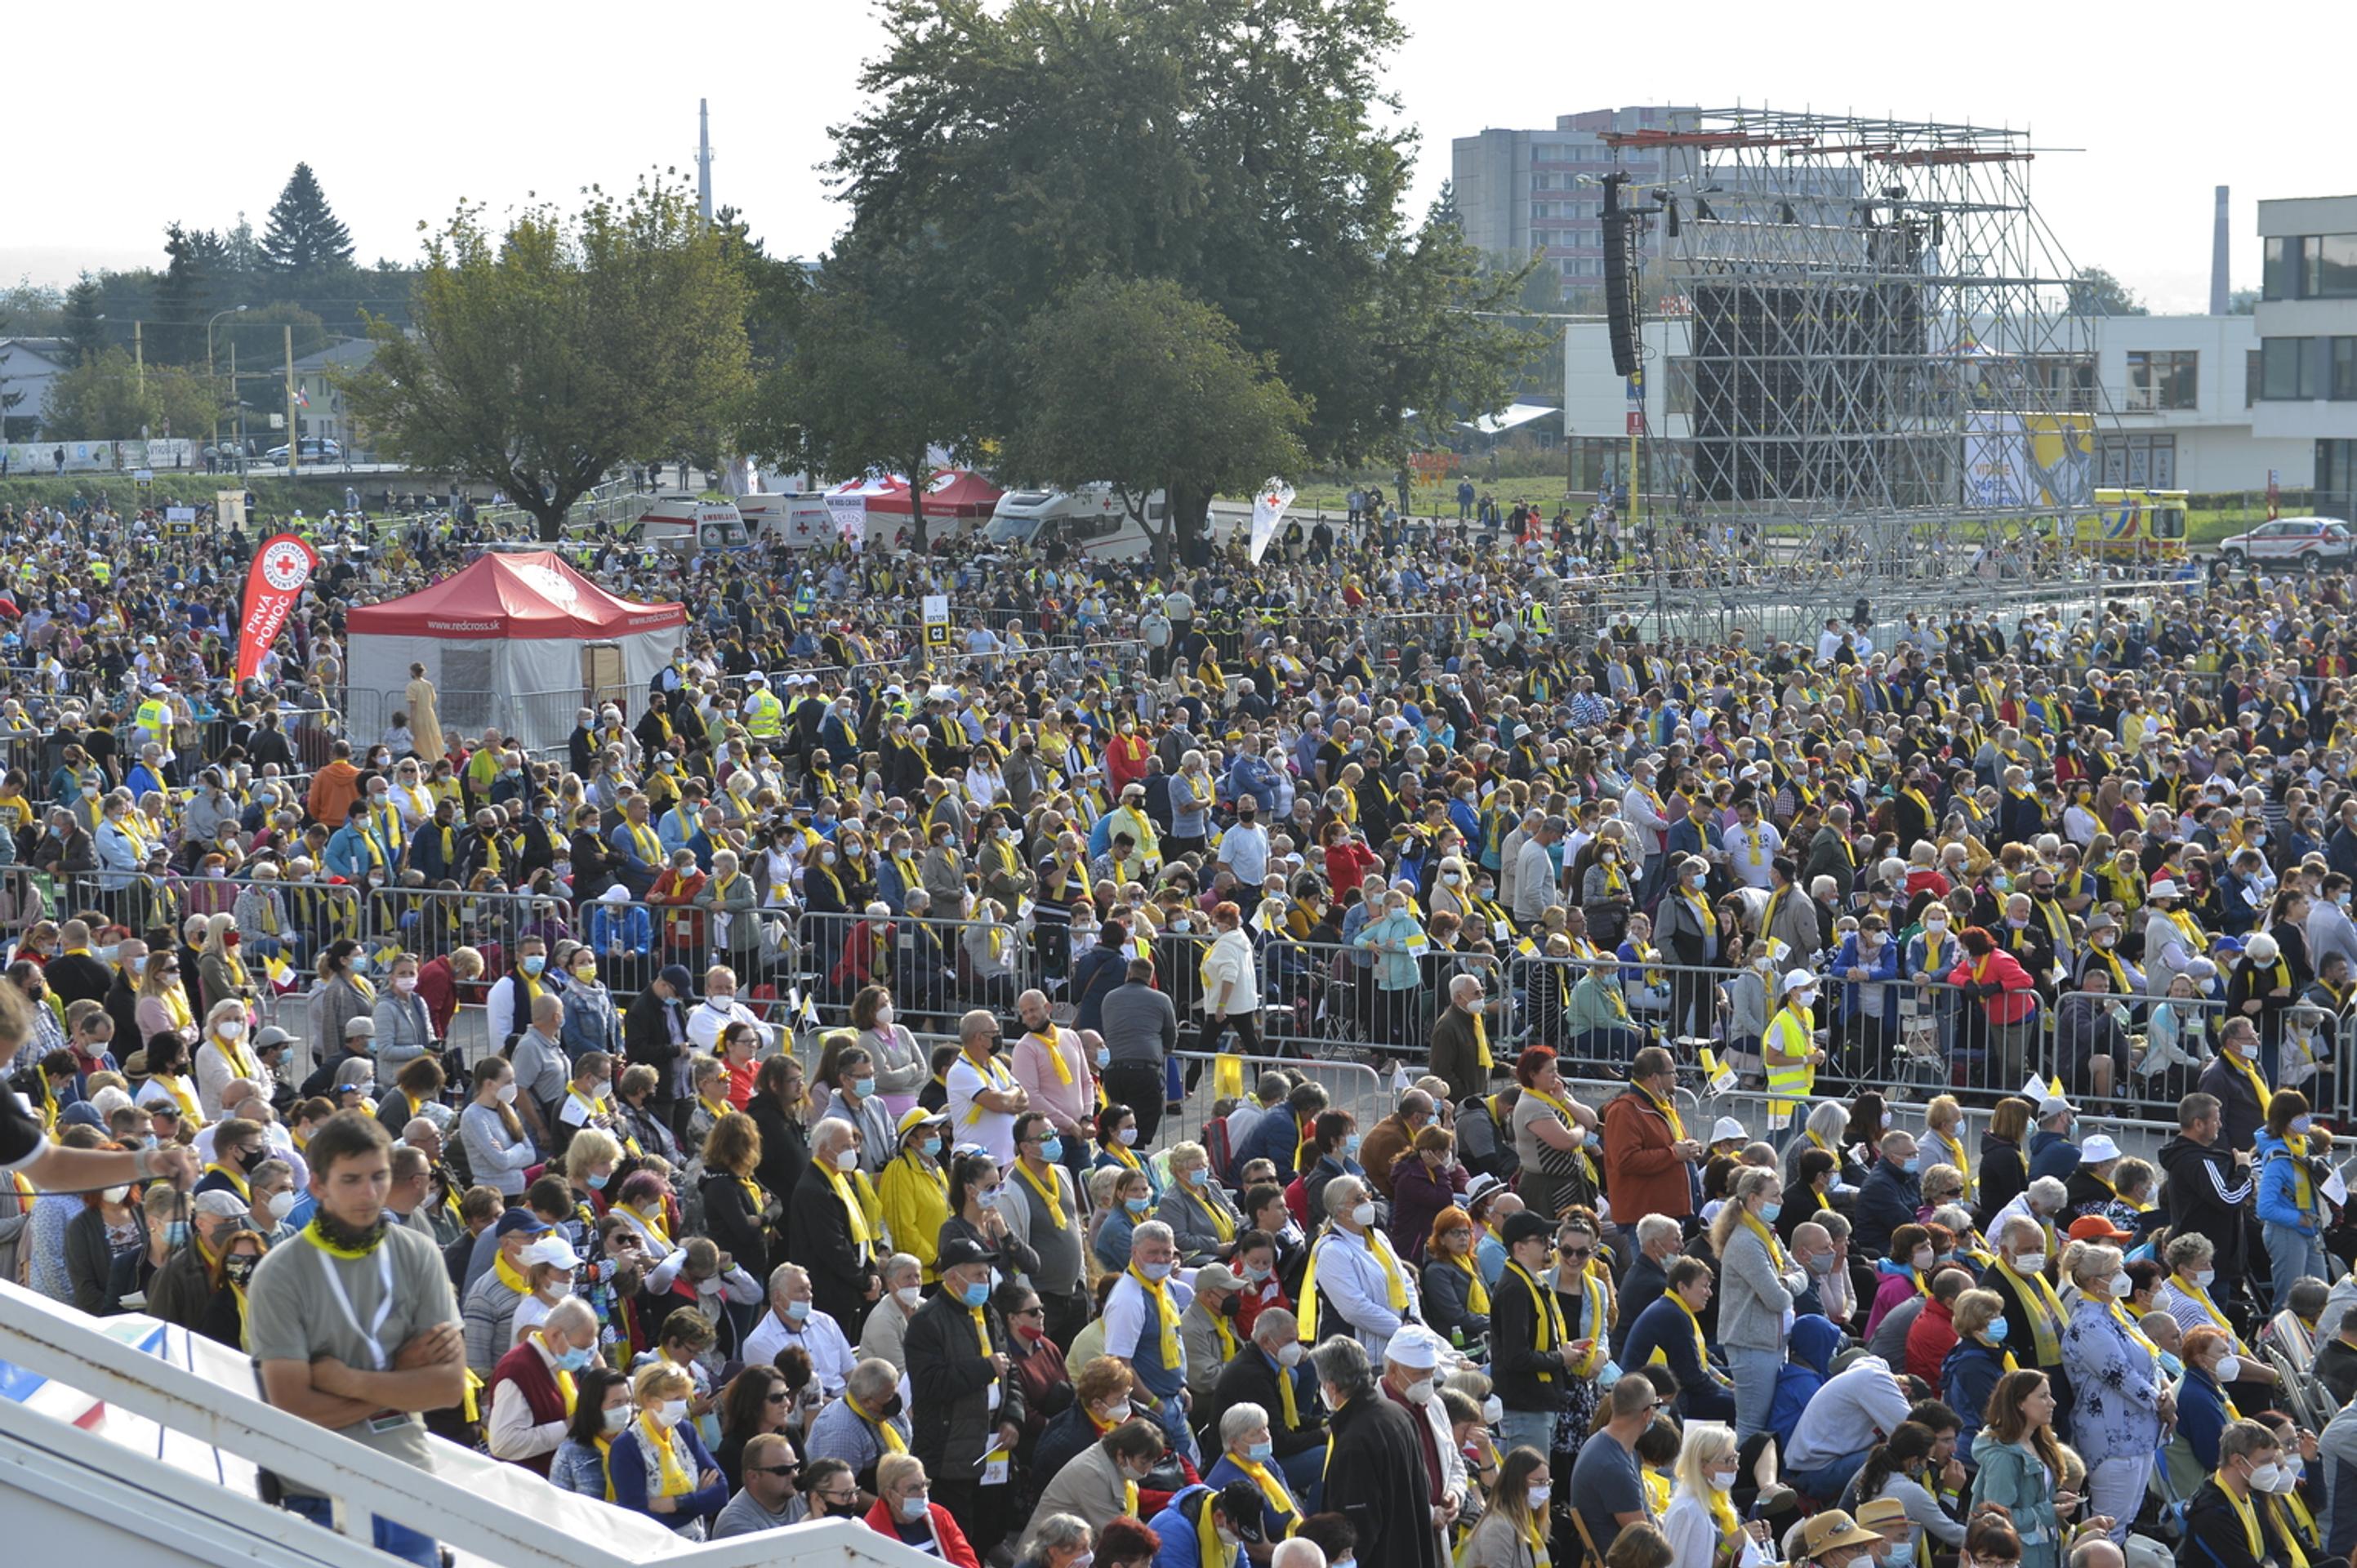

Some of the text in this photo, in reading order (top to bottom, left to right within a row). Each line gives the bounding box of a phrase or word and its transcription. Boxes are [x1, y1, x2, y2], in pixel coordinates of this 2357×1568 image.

[246, 594, 274, 635] PRVÁ
[255, 595, 290, 648] POMOC
[427, 621, 501, 631] www.redcross.sk
[931, 627, 944, 640] C2
